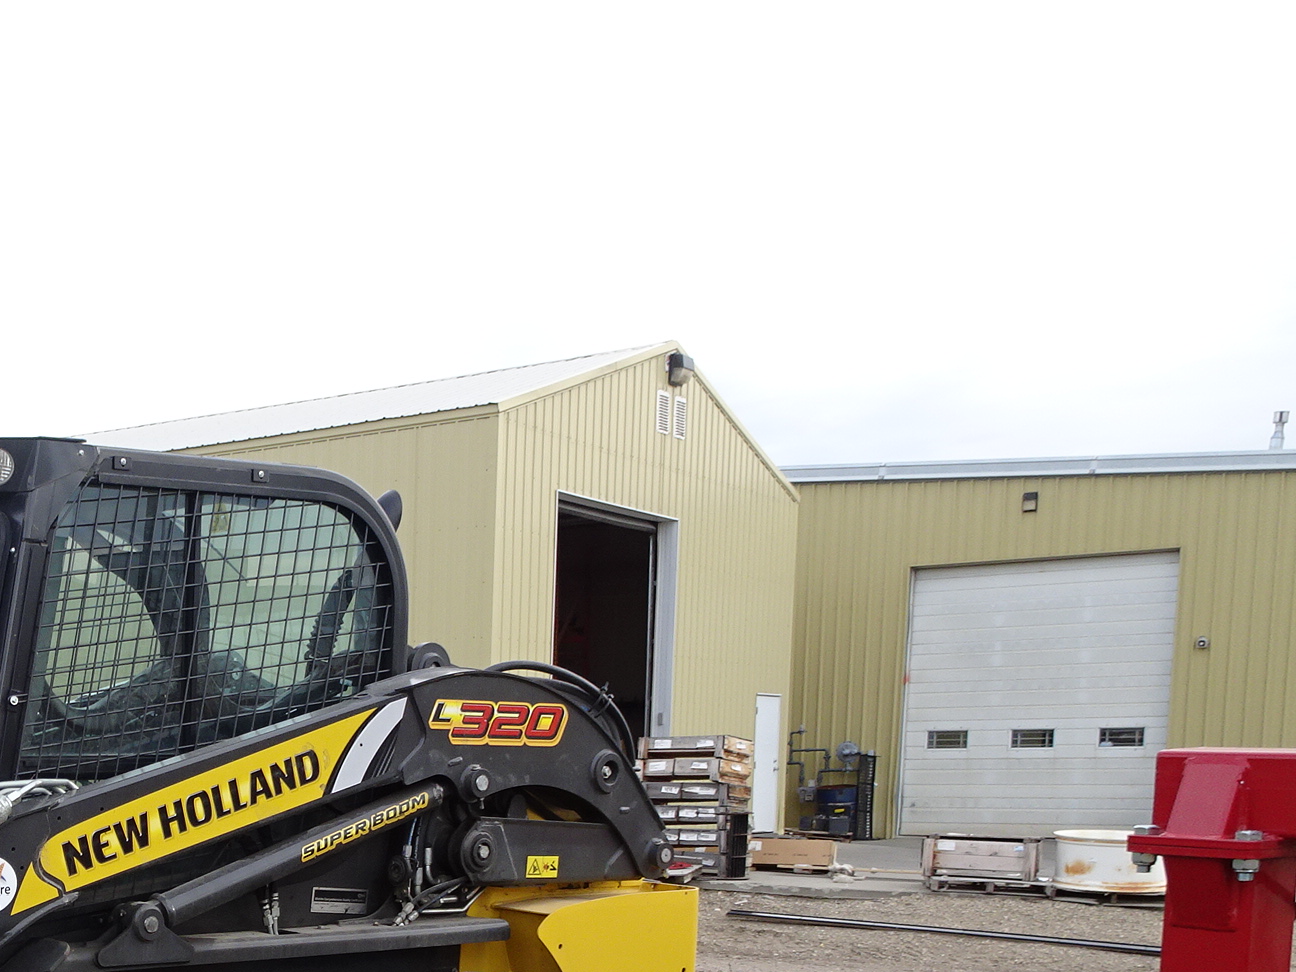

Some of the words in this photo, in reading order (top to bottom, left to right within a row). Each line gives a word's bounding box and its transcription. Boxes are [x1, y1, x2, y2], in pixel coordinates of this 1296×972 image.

[430, 700, 567, 744] L320
[61, 811, 150, 878] NEW
[157, 749, 321, 841] HOLLAND
[301, 818, 369, 862] SUPER
[370, 792, 429, 832] BOOM
